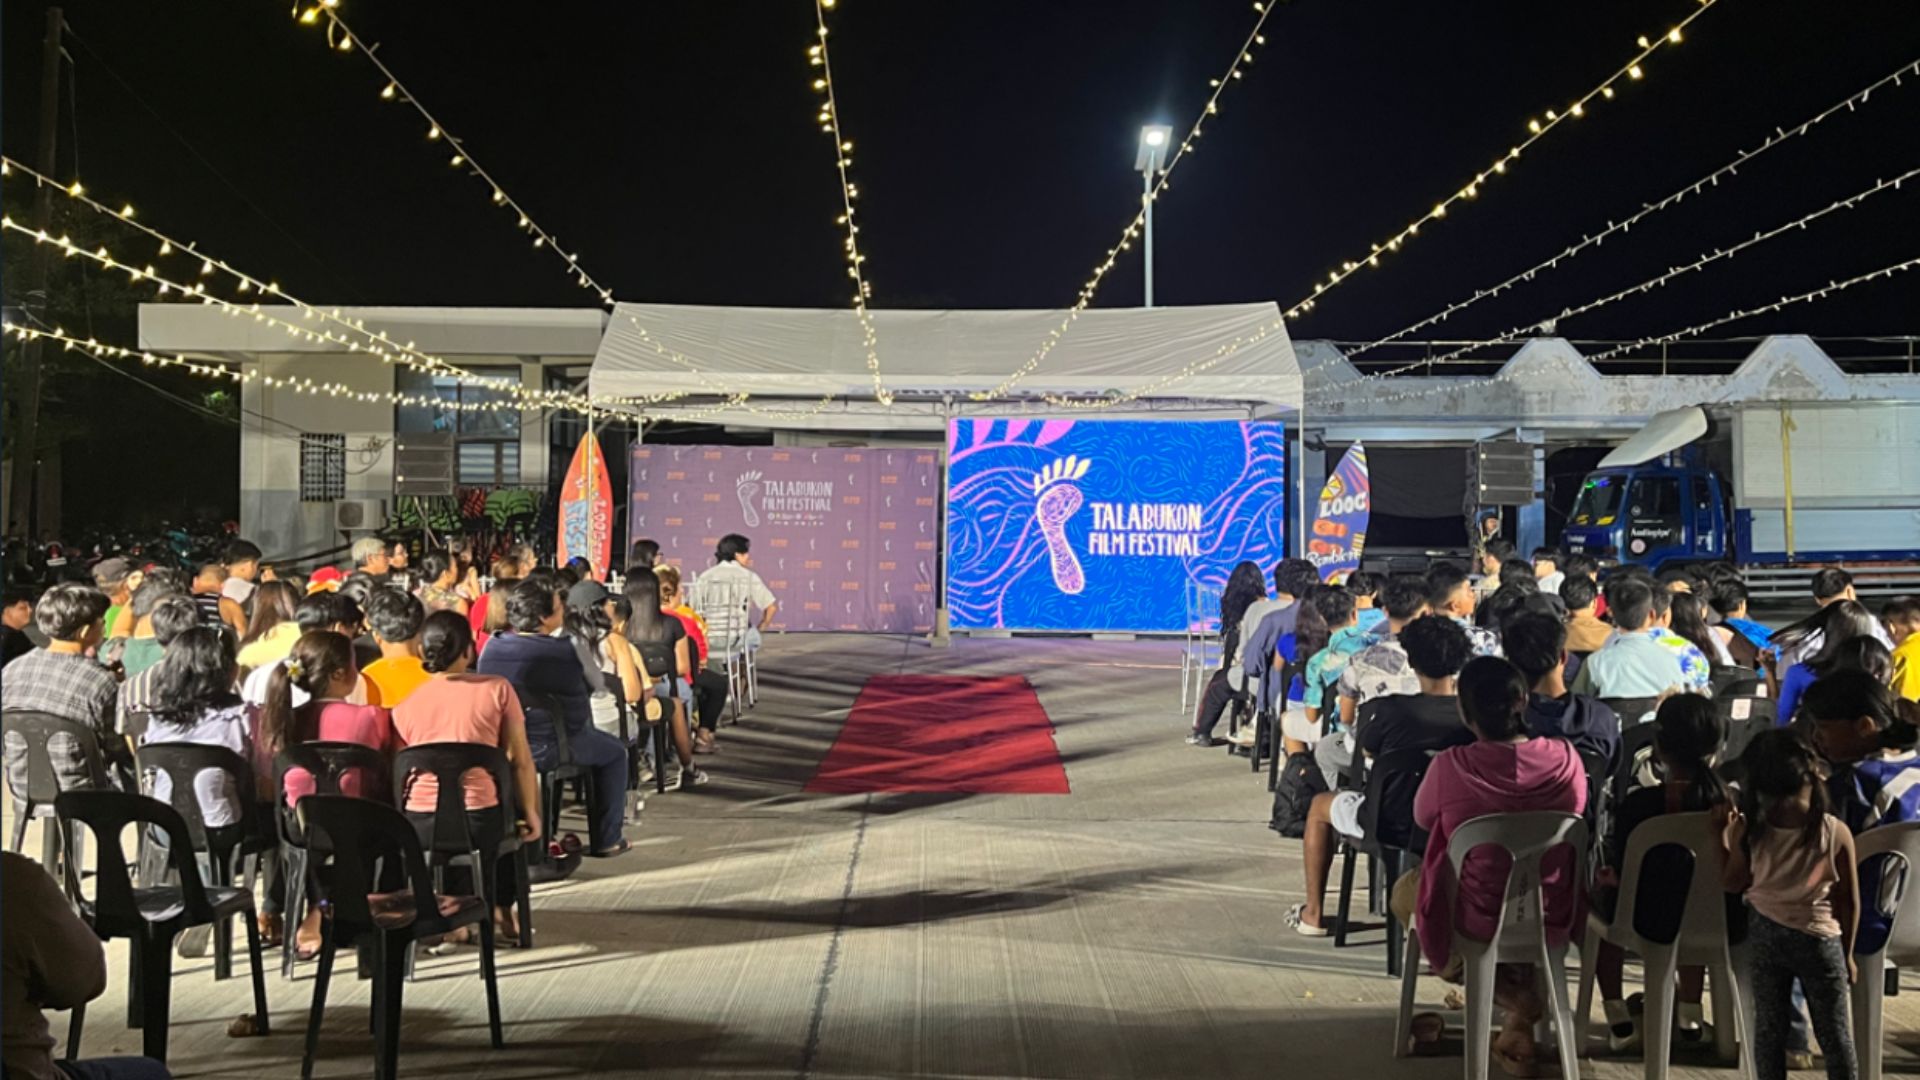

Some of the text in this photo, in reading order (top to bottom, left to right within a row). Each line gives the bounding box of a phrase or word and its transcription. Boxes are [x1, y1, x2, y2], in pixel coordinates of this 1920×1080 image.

[762, 480, 833, 497] TALABUKON
[762, 497, 785, 511] FILM
[786, 497, 832, 512] FESTIVAL
[1089, 502, 1202, 531] TALABUKON
[1088, 531, 1200, 557] FILM FESTIVAL
